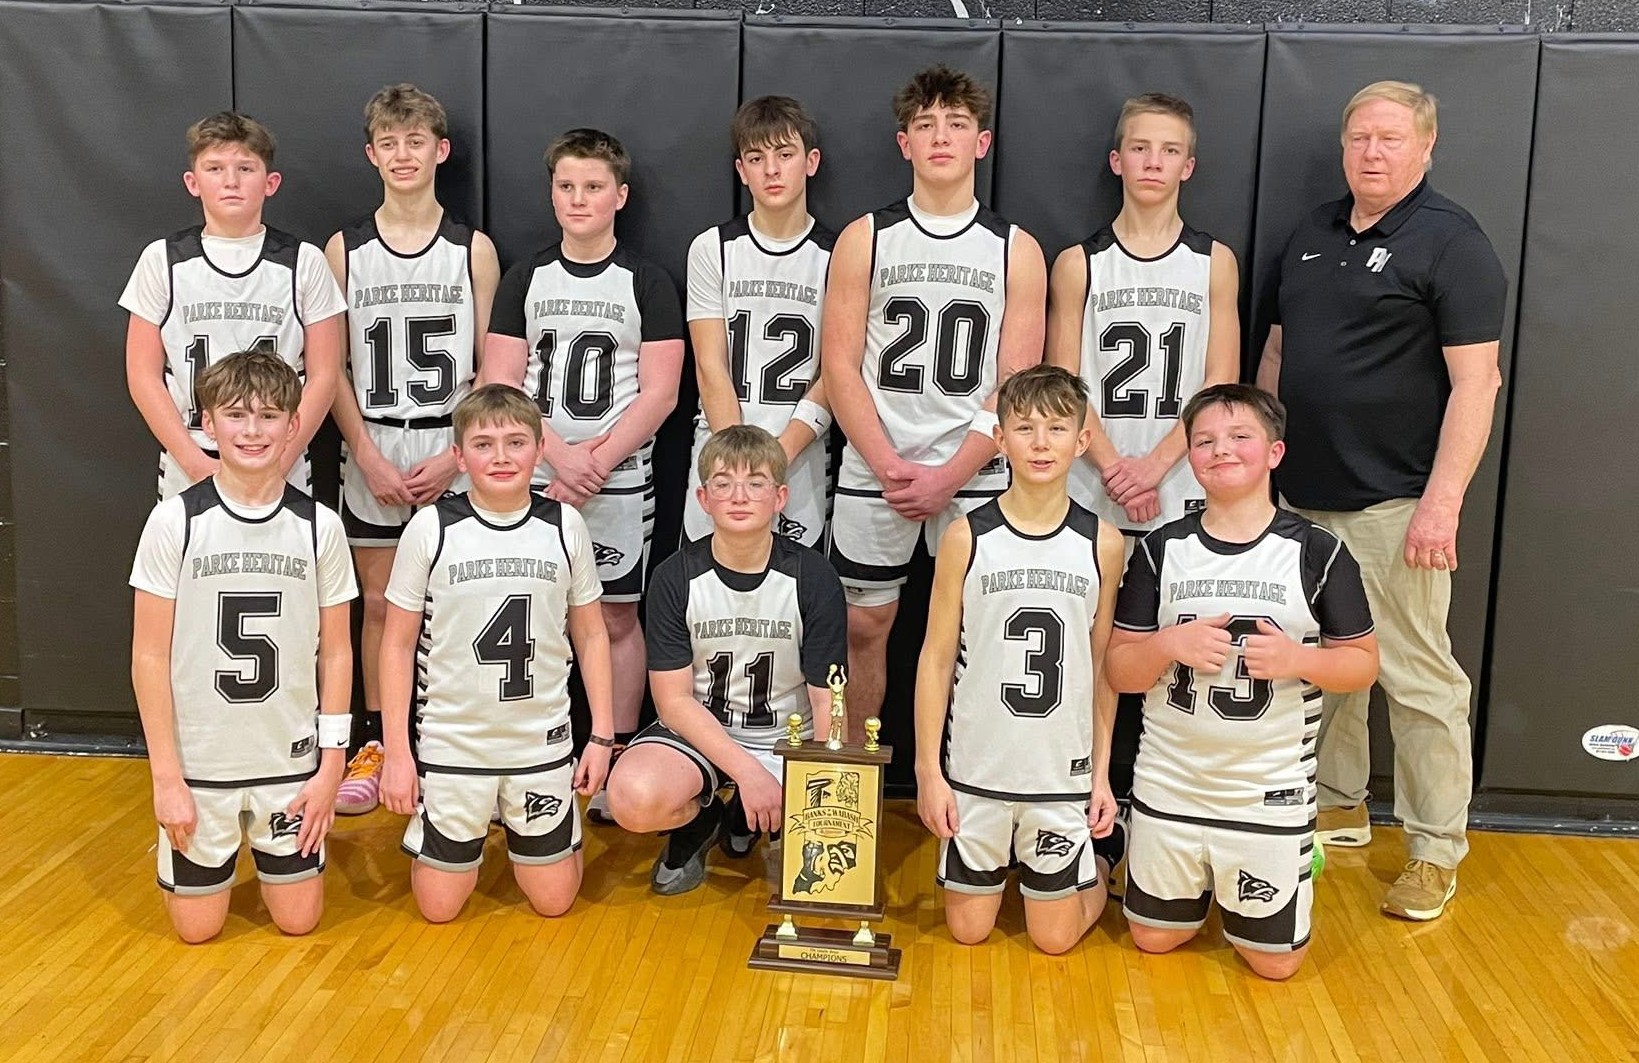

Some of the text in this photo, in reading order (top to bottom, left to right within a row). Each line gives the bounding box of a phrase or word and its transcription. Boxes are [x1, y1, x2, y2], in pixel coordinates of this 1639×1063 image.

[729, 280, 818, 305] PARKE HERITAGE
[880, 263, 995, 293] PARKE HERITAGE
[355, 284, 463, 308] PARKE HERITAGE
[1092, 287, 1203, 315] PARKE HERITAGE
[183, 302, 286, 325] PARKE HERITAGE
[534, 300, 625, 323] PARKE HERITAGE
[365, 314, 457, 409] 15
[728, 310, 814, 405] 12
[877, 297, 990, 396] 20
[185, 335, 277, 430] 1
[533, 329, 619, 420] 10
[1100, 322, 1185, 419] 21
[192, 552, 308, 580] PARKE HERITAGE
[448, 558, 558, 585] PARKE HERITAGE
[981, 569, 1089, 599] PARKE HERITAGE
[1170, 580, 1287, 605] PARKE HERITAGE
[694, 618, 791, 640] PARKE HERITAGE
[214, 591, 282, 704] 5
[472, 594, 535, 701] 4
[1000, 607, 1065, 718] 3
[703, 651, 777, 729] 11
[813, 820, 850, 829] TOURNAMENT
[800, 951, 847, 963] CHAMPIONS
